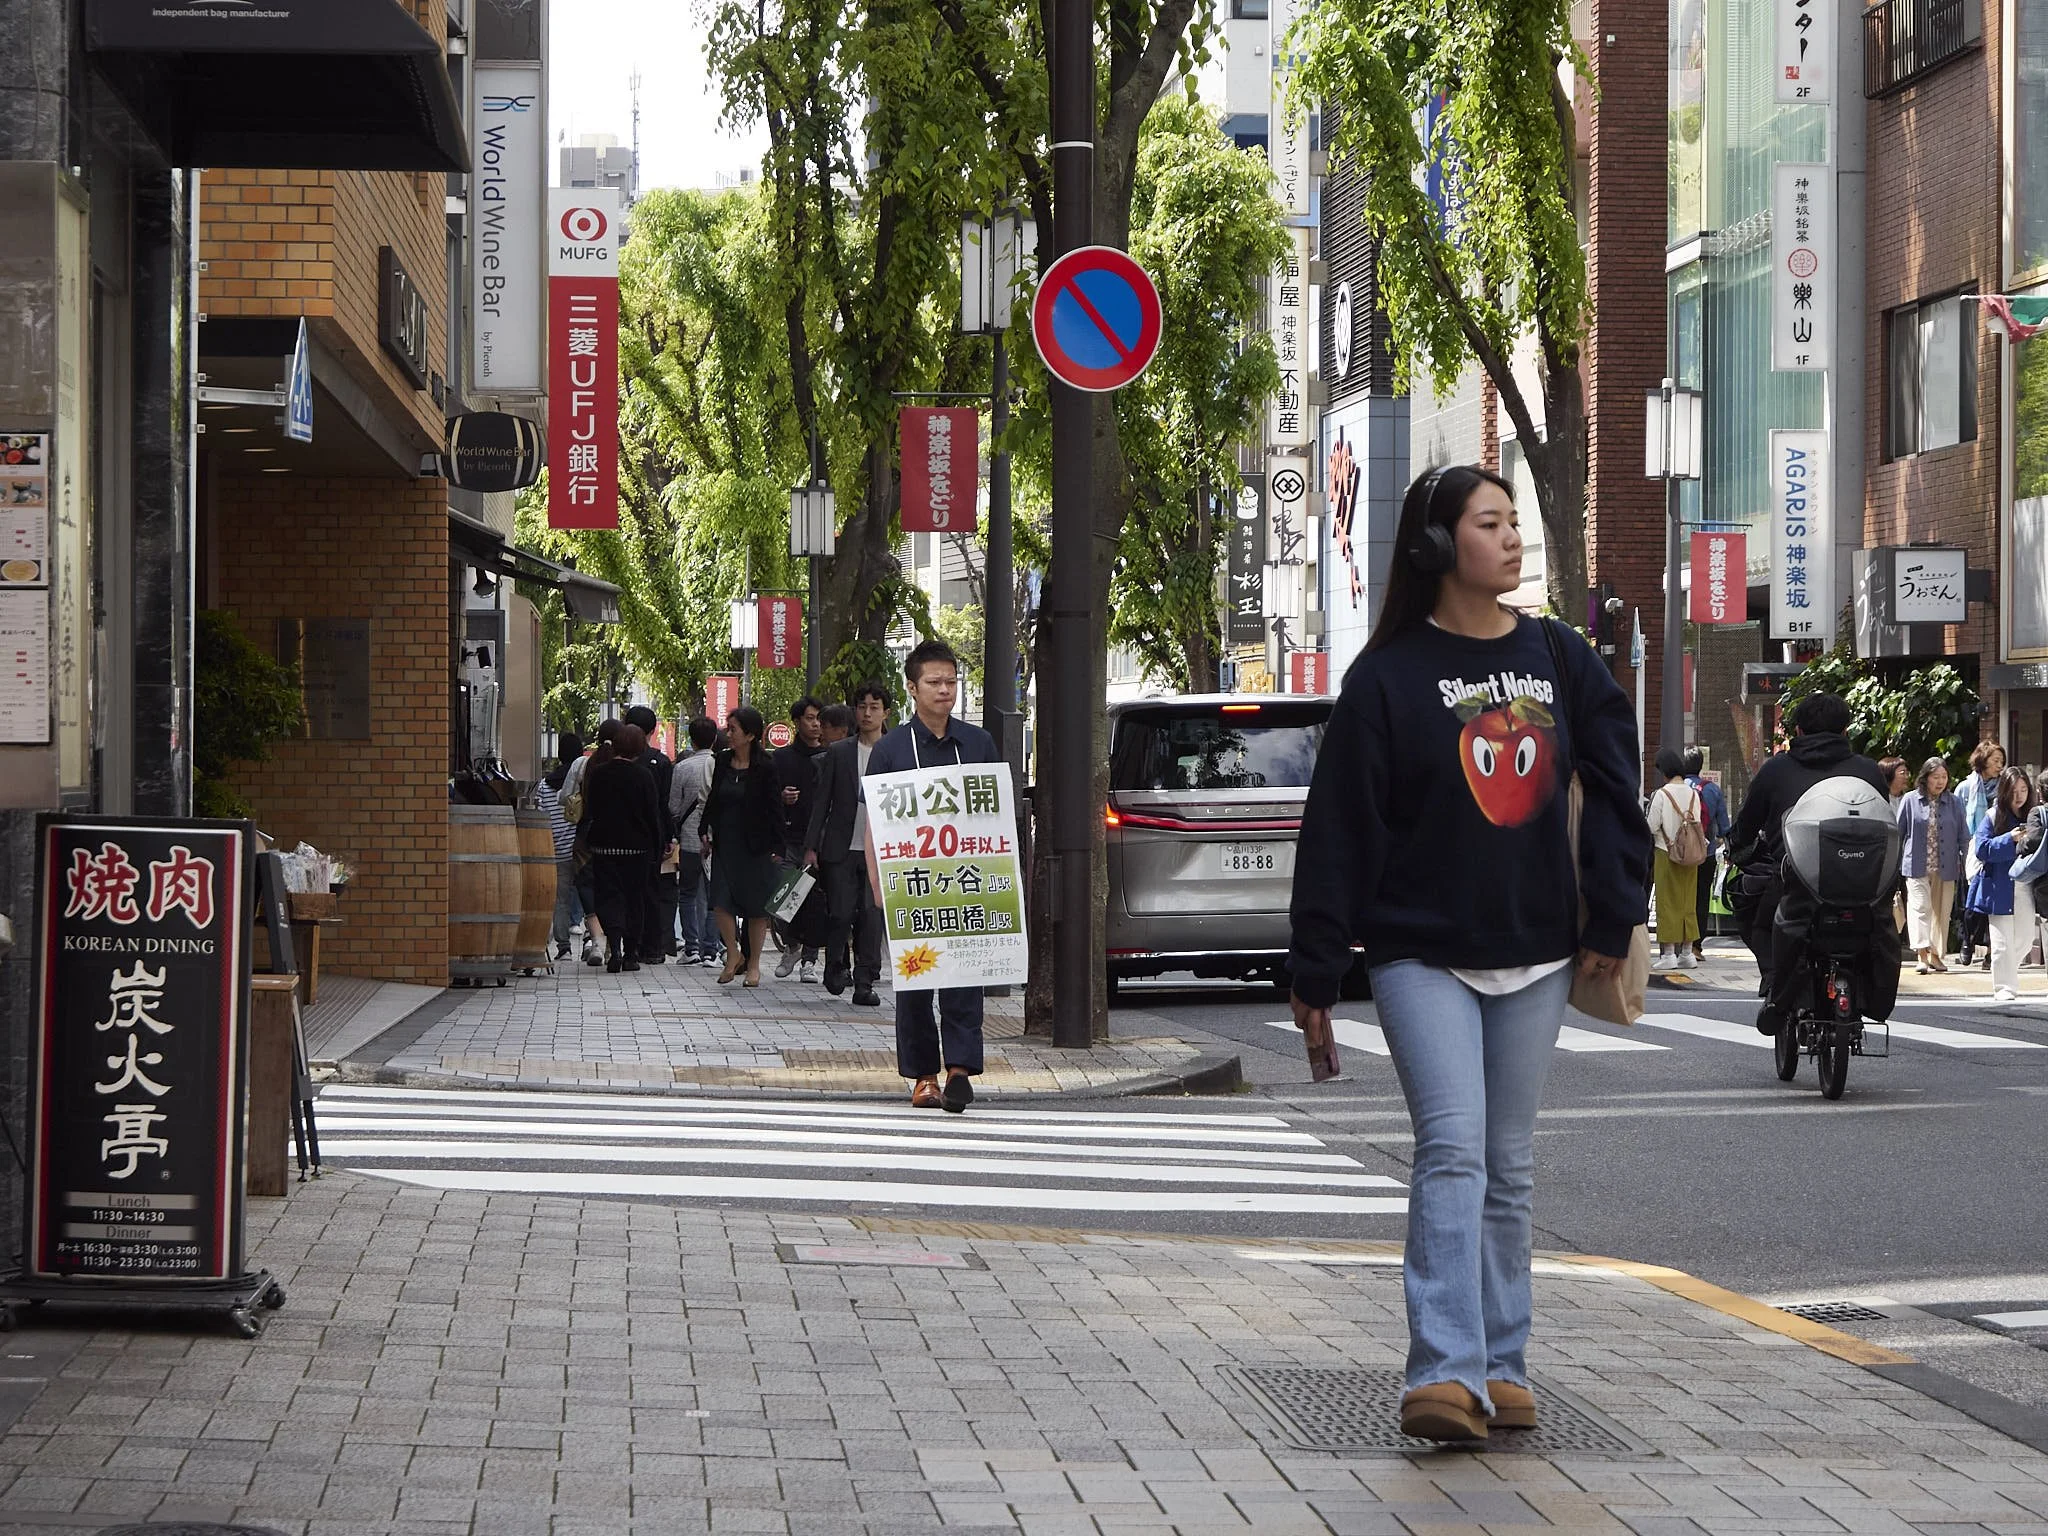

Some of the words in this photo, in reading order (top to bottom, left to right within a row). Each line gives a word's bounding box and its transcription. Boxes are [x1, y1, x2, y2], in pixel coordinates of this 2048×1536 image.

[152, 8, 209, 18] independent
[210, 9, 228, 19] bag
[229, 9, 290, 18] manufacturer
[1794, 0, 1813, 63] ター
[1796, 86, 1811, 97] 2F
[483, 125, 506, 201] World
[483, 204, 505, 270] Wine
[560, 247, 608, 260] MUFG
[483, 275, 506, 318] Bar
[483, 331, 492, 344] by
[1281, 314, 1297, 362] 神楽坂
[1795, 355, 1810, 365] 1F
[568, 295, 598, 505] 三菱UFJ銀行
[1278, 369, 1300, 433] 不動産
[453, 446, 484, 457] World
[486, 446, 513, 457] Wine
[514, 446, 532, 457] Bar
[1785, 447, 1806, 538] AGARIS
[1232, 571, 1262, 615] 杉玉
[1785, 543, 1810, 609] 神楽坂
[1899, 576, 1958, 600] うおさん
[1789, 621, 1813, 632] B1F
[1438, 673, 1501, 708] Silent
[1500, 671, 1554, 704] Noise
[877, 775, 1000, 820] 初公開
[879, 824, 1012, 860] 土地20坪以上
[1233, 855, 1273, 870] 88-88
[63, 841, 216, 930] 焼肉
[64, 935, 140, 951] KOREAN
[145, 938, 215, 954] DINING
[904, 950, 932, 974] 近く
[95, 959, 175, 1181] 炭火亭
[108, 1194, 150, 1207] Lunch
[105, 1226, 152, 1239] Dinner
